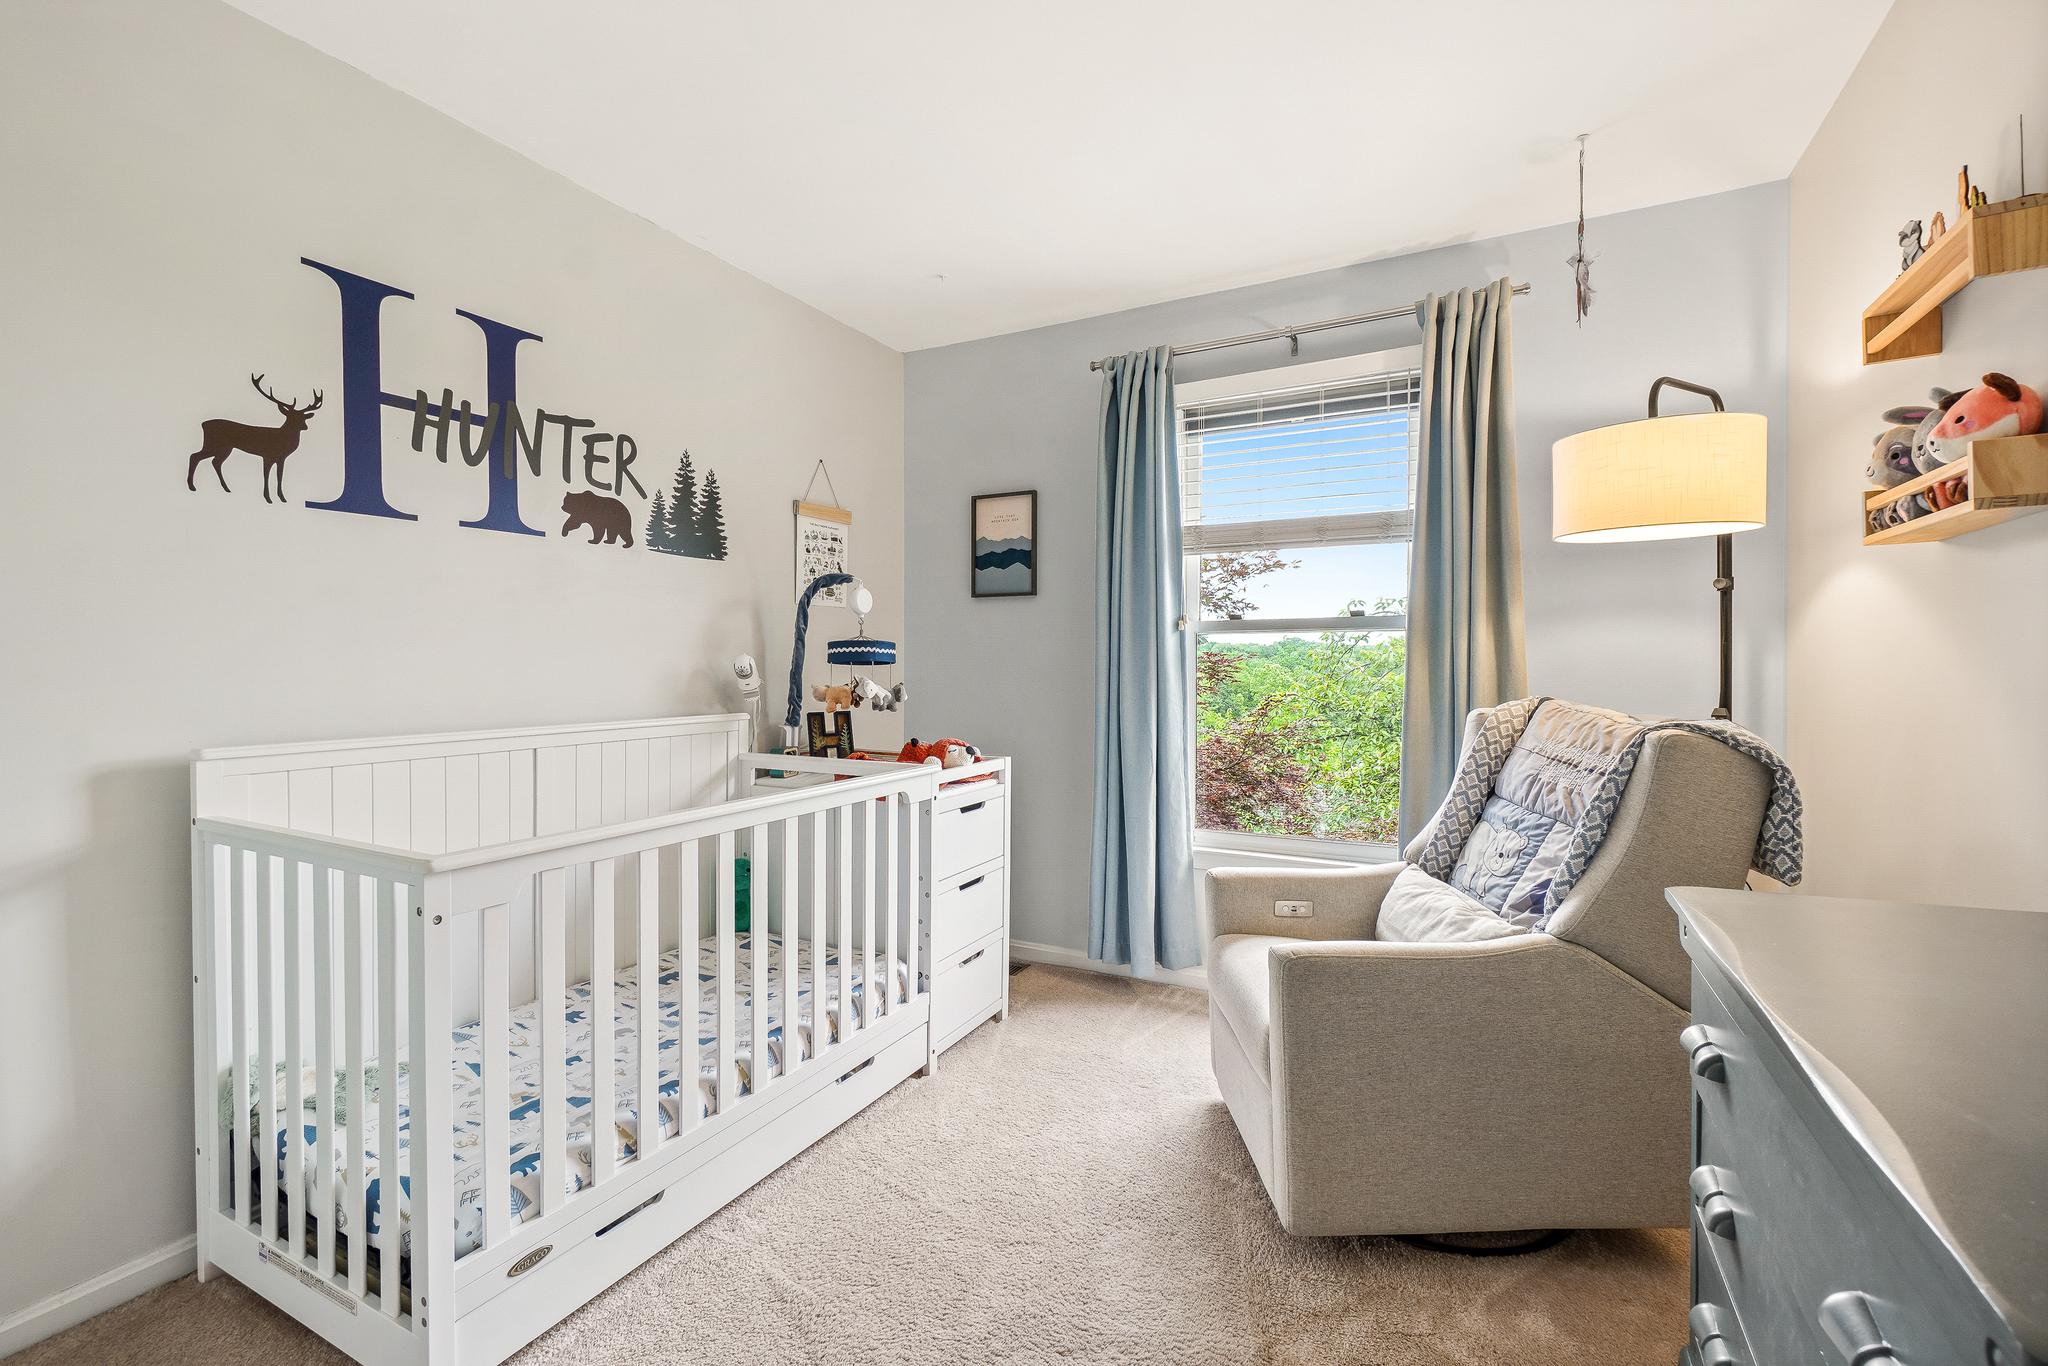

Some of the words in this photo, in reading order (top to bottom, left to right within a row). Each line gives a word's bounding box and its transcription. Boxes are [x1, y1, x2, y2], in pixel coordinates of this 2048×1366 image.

[300, 256, 546, 538] H
[411, 388, 648, 500] HUNTER
[807, 710, 855, 758] H
[517, 1248, 548, 1270] GRACO
